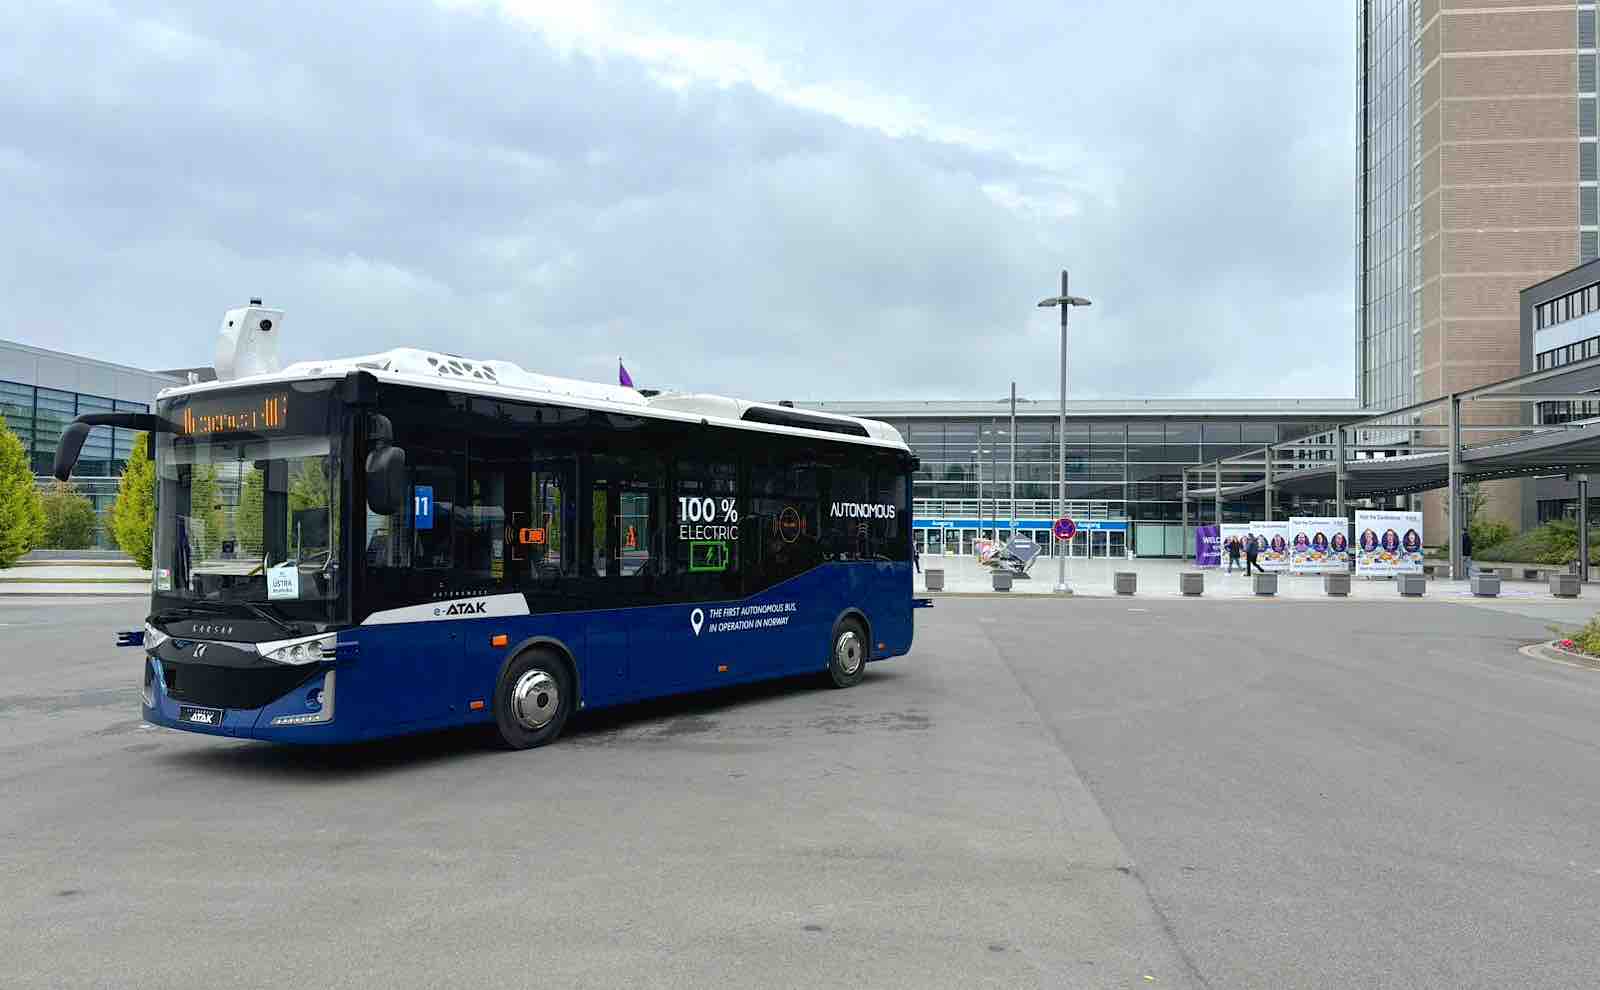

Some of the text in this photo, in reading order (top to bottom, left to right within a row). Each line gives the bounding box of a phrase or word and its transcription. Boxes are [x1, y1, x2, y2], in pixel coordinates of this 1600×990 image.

[414, 496, 429, 516] 11
[679, 497, 738, 523] 100 %
[830, 502, 896, 519] AUTONOMOUS
[680, 525, 739, 541] ELECTRIC
[709, 608, 722, 619] THE
[723, 607, 740, 617] FIRST
[741, 604, 784, 616] AUTONOMOUS
[709, 617, 789, 632] IN OPERATION IN NORWAY
[190, 712, 214, 723] ATAK
